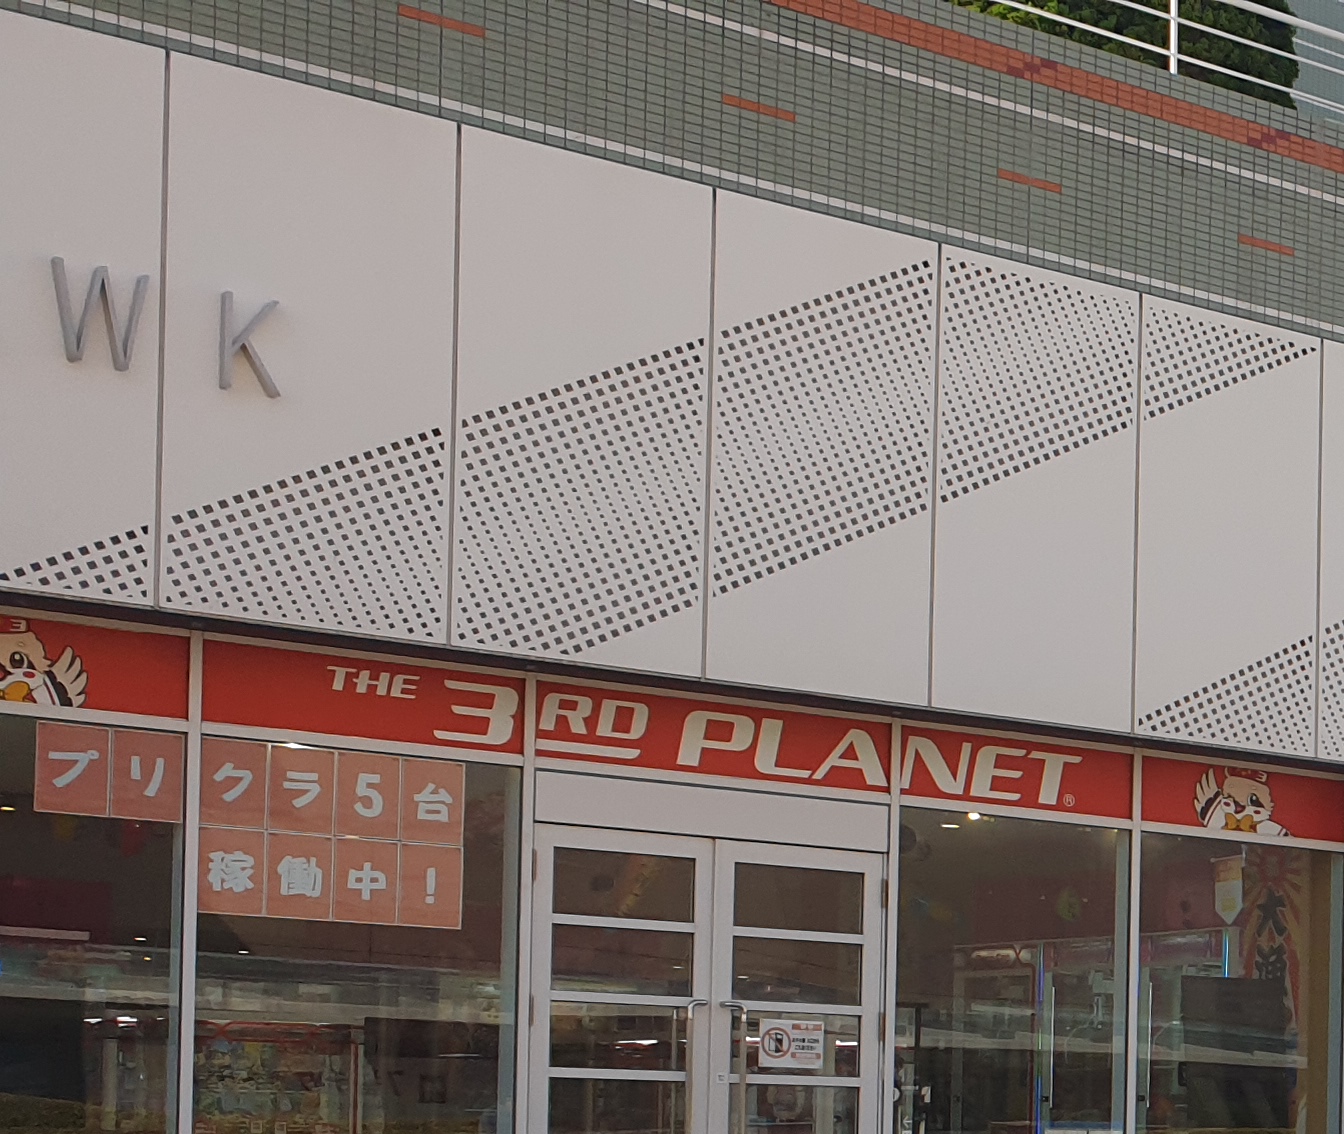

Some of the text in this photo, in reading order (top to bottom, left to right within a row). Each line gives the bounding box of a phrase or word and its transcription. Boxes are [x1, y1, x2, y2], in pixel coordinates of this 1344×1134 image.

[48, 749, 454, 822] プリクラ5台
[326, 665, 1084, 806] THE 3RD PLANET
